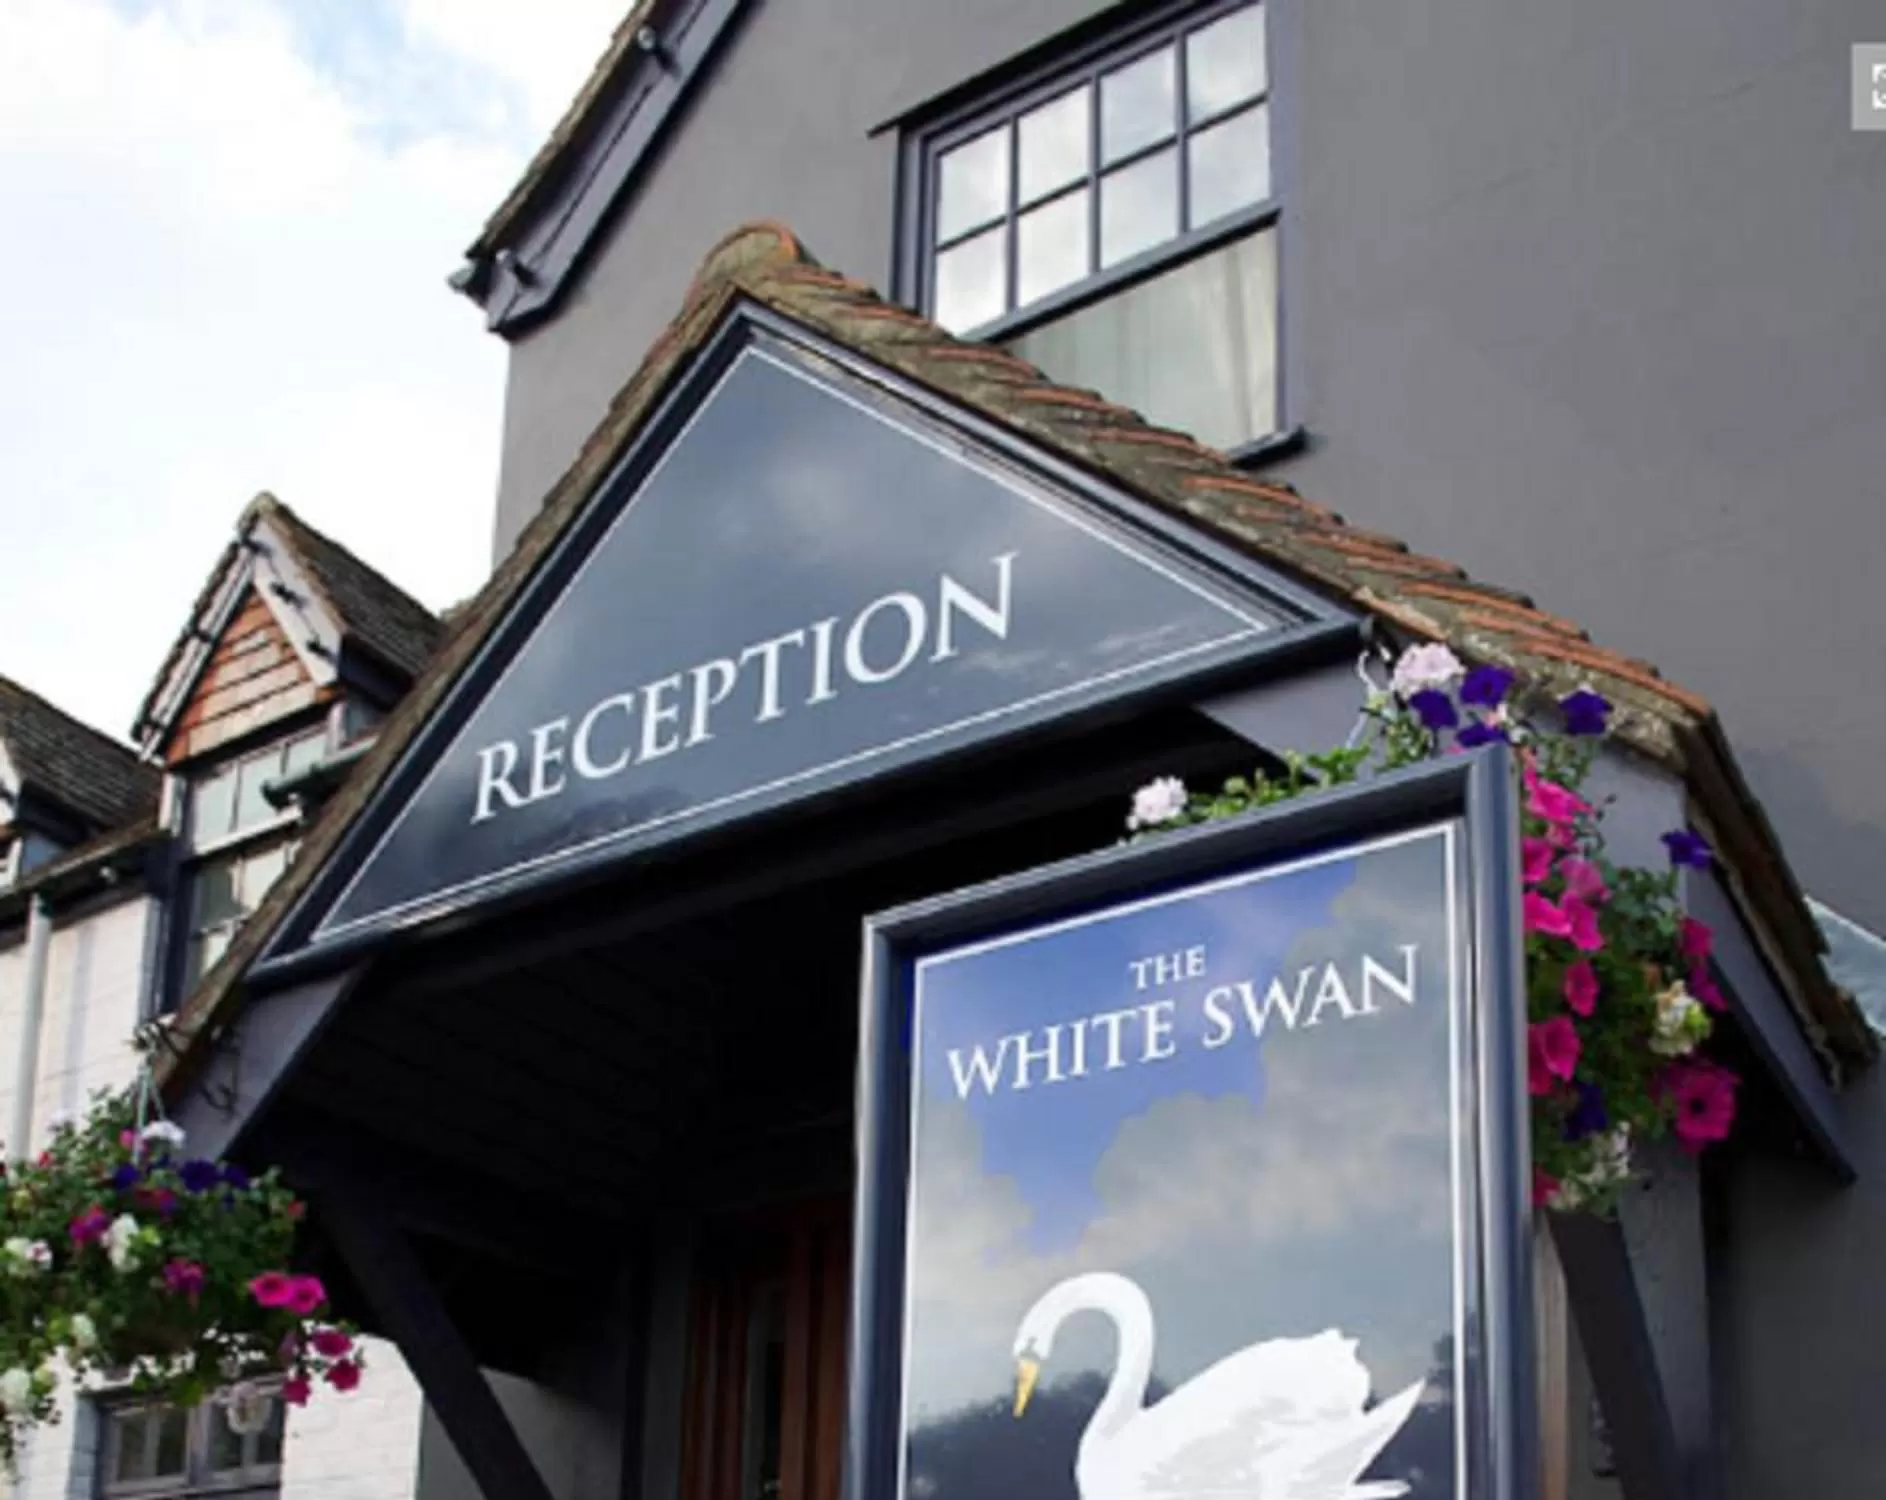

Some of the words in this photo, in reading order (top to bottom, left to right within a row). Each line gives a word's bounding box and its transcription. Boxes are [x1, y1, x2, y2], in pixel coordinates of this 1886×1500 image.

[469, 551, 1019, 824] RECEPTION
[947, 1000, 1176, 1100] WHITE
[1202, 944, 1418, 1049] SWAN
[1130, 944, 1207, 991] THE
